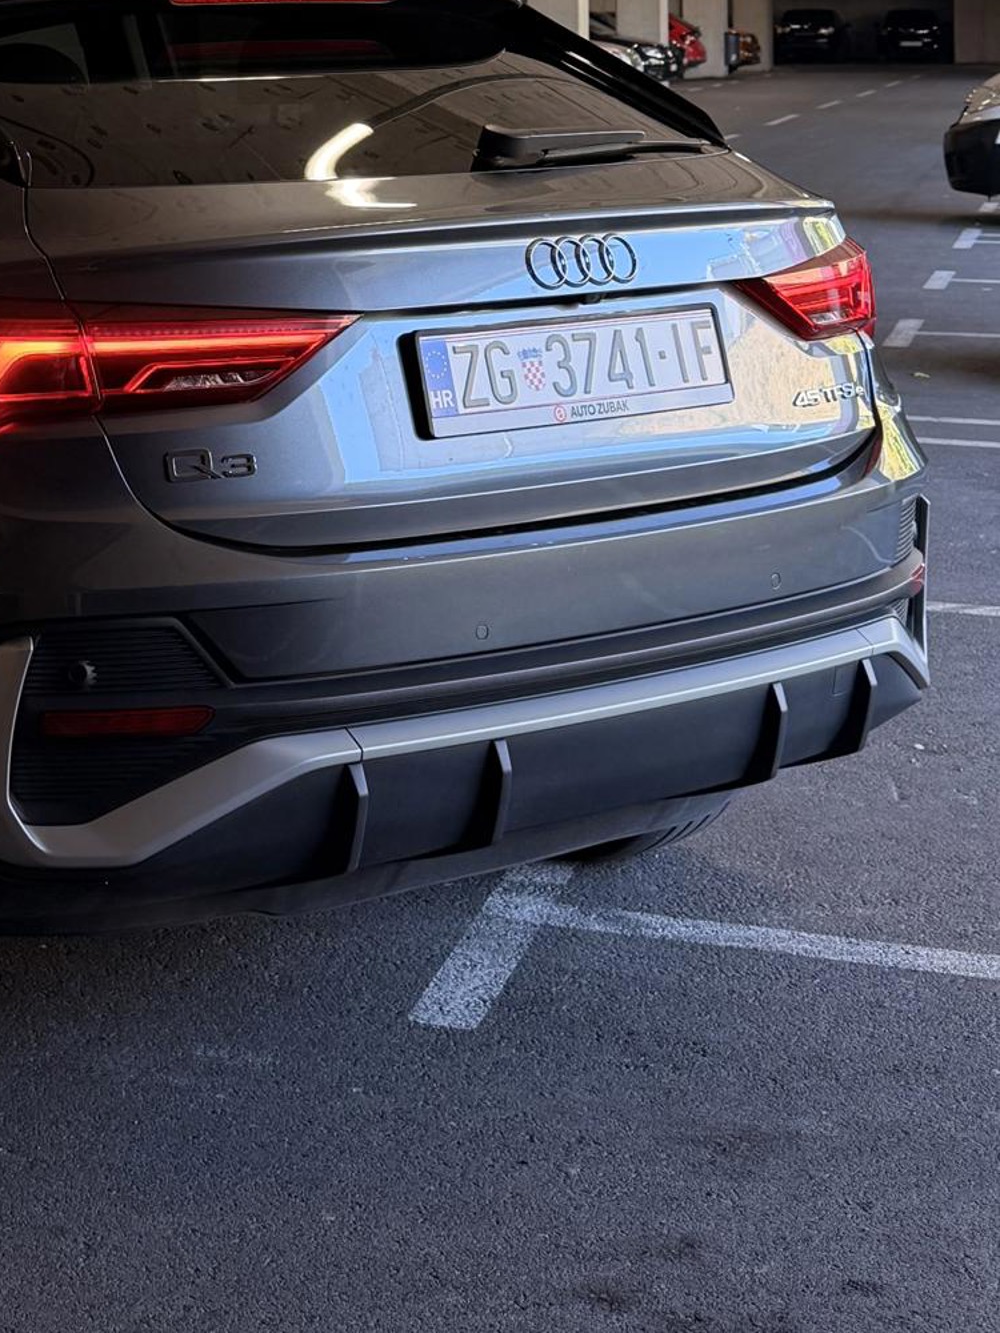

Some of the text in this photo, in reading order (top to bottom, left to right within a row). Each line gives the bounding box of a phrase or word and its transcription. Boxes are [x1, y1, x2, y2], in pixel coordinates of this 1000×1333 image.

[452, 340, 519, 409] ZG
[430, 389, 455, 409] HR
[793, 389, 820, 407] 45
[570, 399, 630, 418] AUTO ZUBAK
[163, 447, 258, 484] Q3
